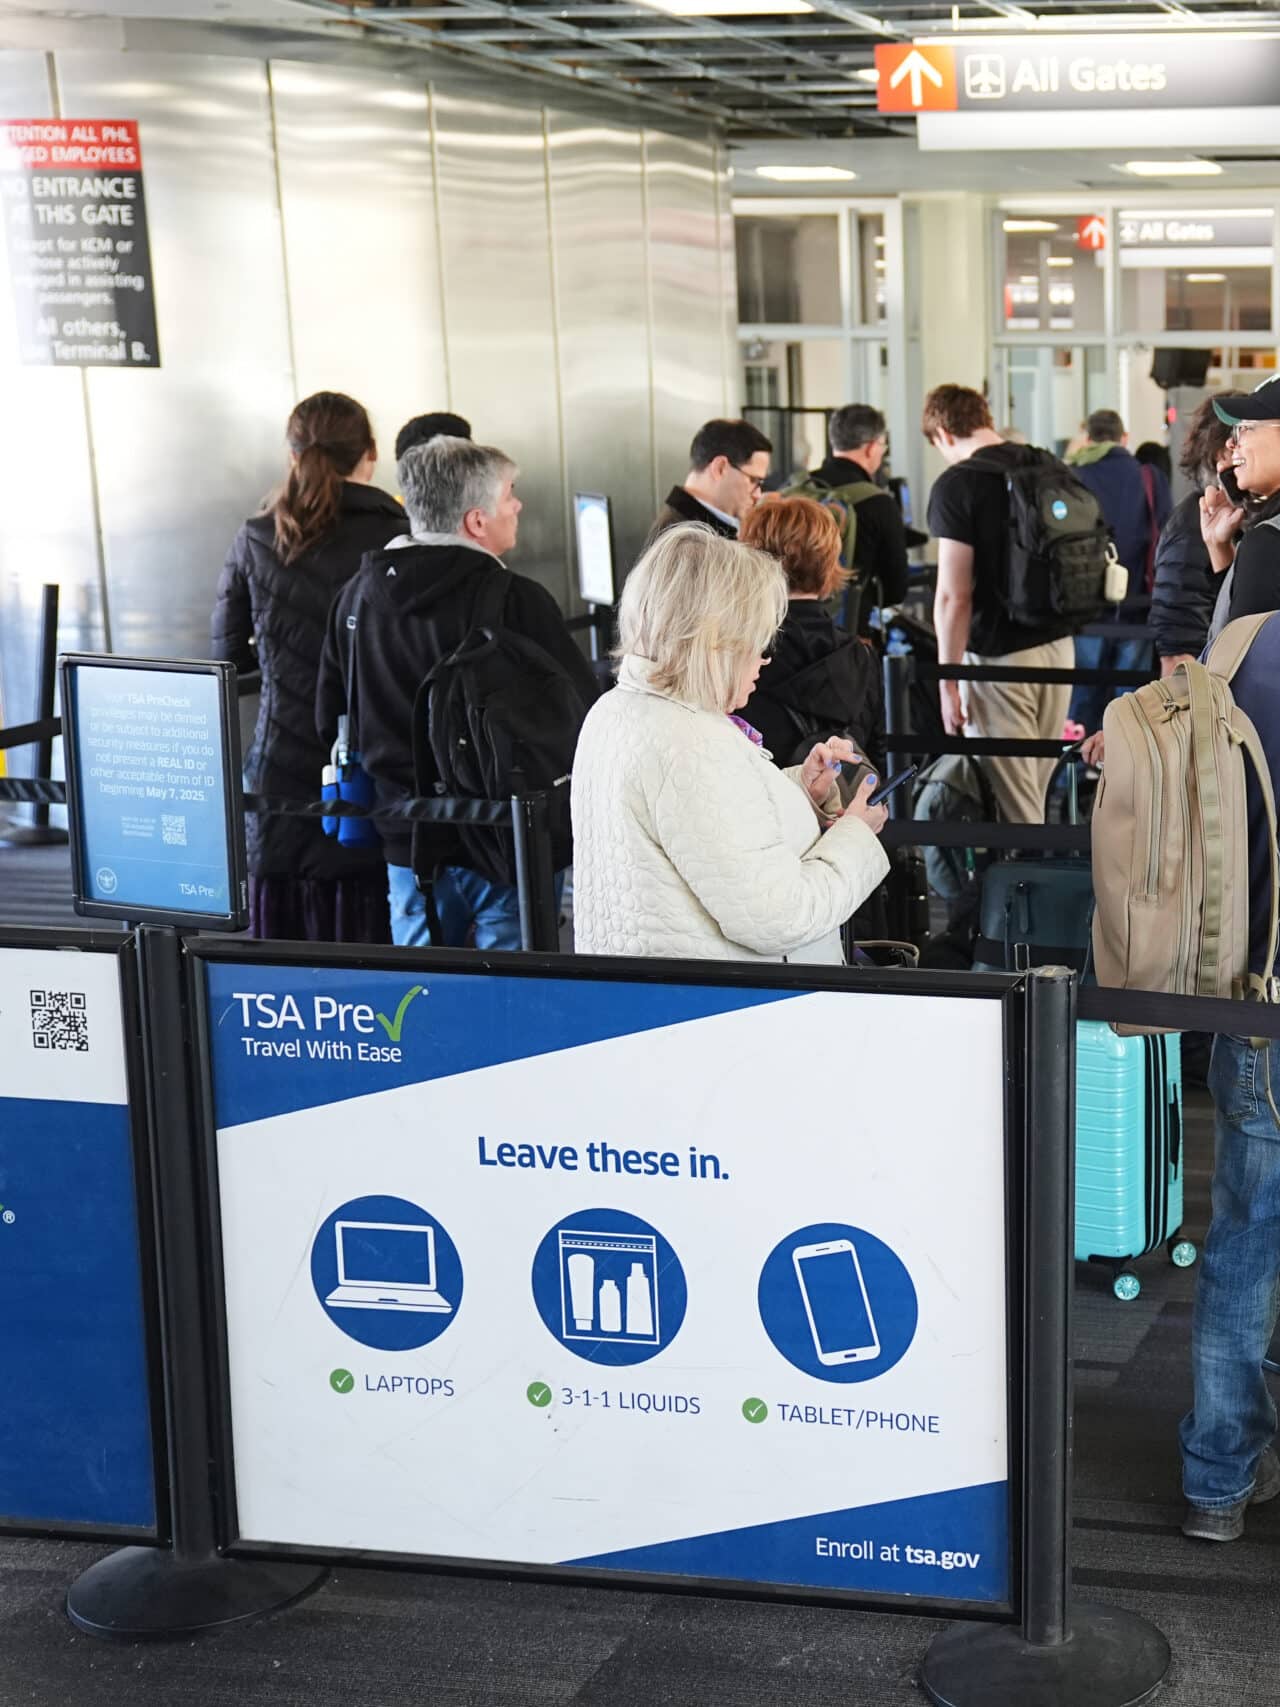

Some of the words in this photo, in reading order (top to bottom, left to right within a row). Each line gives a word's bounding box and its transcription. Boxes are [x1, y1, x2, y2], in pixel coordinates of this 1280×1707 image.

[1012, 55, 1059, 92] All
[1068, 58, 1167, 92] Gates
[71, 126, 97, 142] ALL
[102, 126, 132, 143] PHL
[52, 145, 136, 163] EMPLOYEES
[32, 176, 136, 199] ENTRANCE
[35, 204, 76, 224] THIS
[81, 203, 135, 226] GATE
[1139, 220, 1164, 241] All
[1166, 221, 1214, 241] Gates
[115, 239, 133, 254] or
[54, 340, 126, 361] Terminal
[157, 757, 183, 769] REAL
[184, 759, 194, 770] ID
[146, 786, 167, 800] May
[204, 776, 214, 787] ID
[180, 883, 197, 896] TSA
[199, 885, 215, 897] Pre
[233, 992, 303, 1030] TSA
[313, 994, 375, 1034] Pre
[241, 1037, 300, 1058] Travel
[306, 1039, 353, 1060] With
[358, 1041, 402, 1063] Ease
[478, 1135, 578, 1171] Leave
[586, 1140, 678, 1176] these
[688, 1147, 730, 1181] in.
[364, 1374, 454, 1397] LAPTOPS
[561, 1387, 611, 1409] 3-1-1
[619, 1391, 701, 1415] LIQUIDS
[777, 1402, 941, 1434] TABLET/PHONE
[815, 1536, 874, 1563] Enroll
[879, 1543, 900, 1563] at
[904, 1545, 981, 1572] tsa.gov
